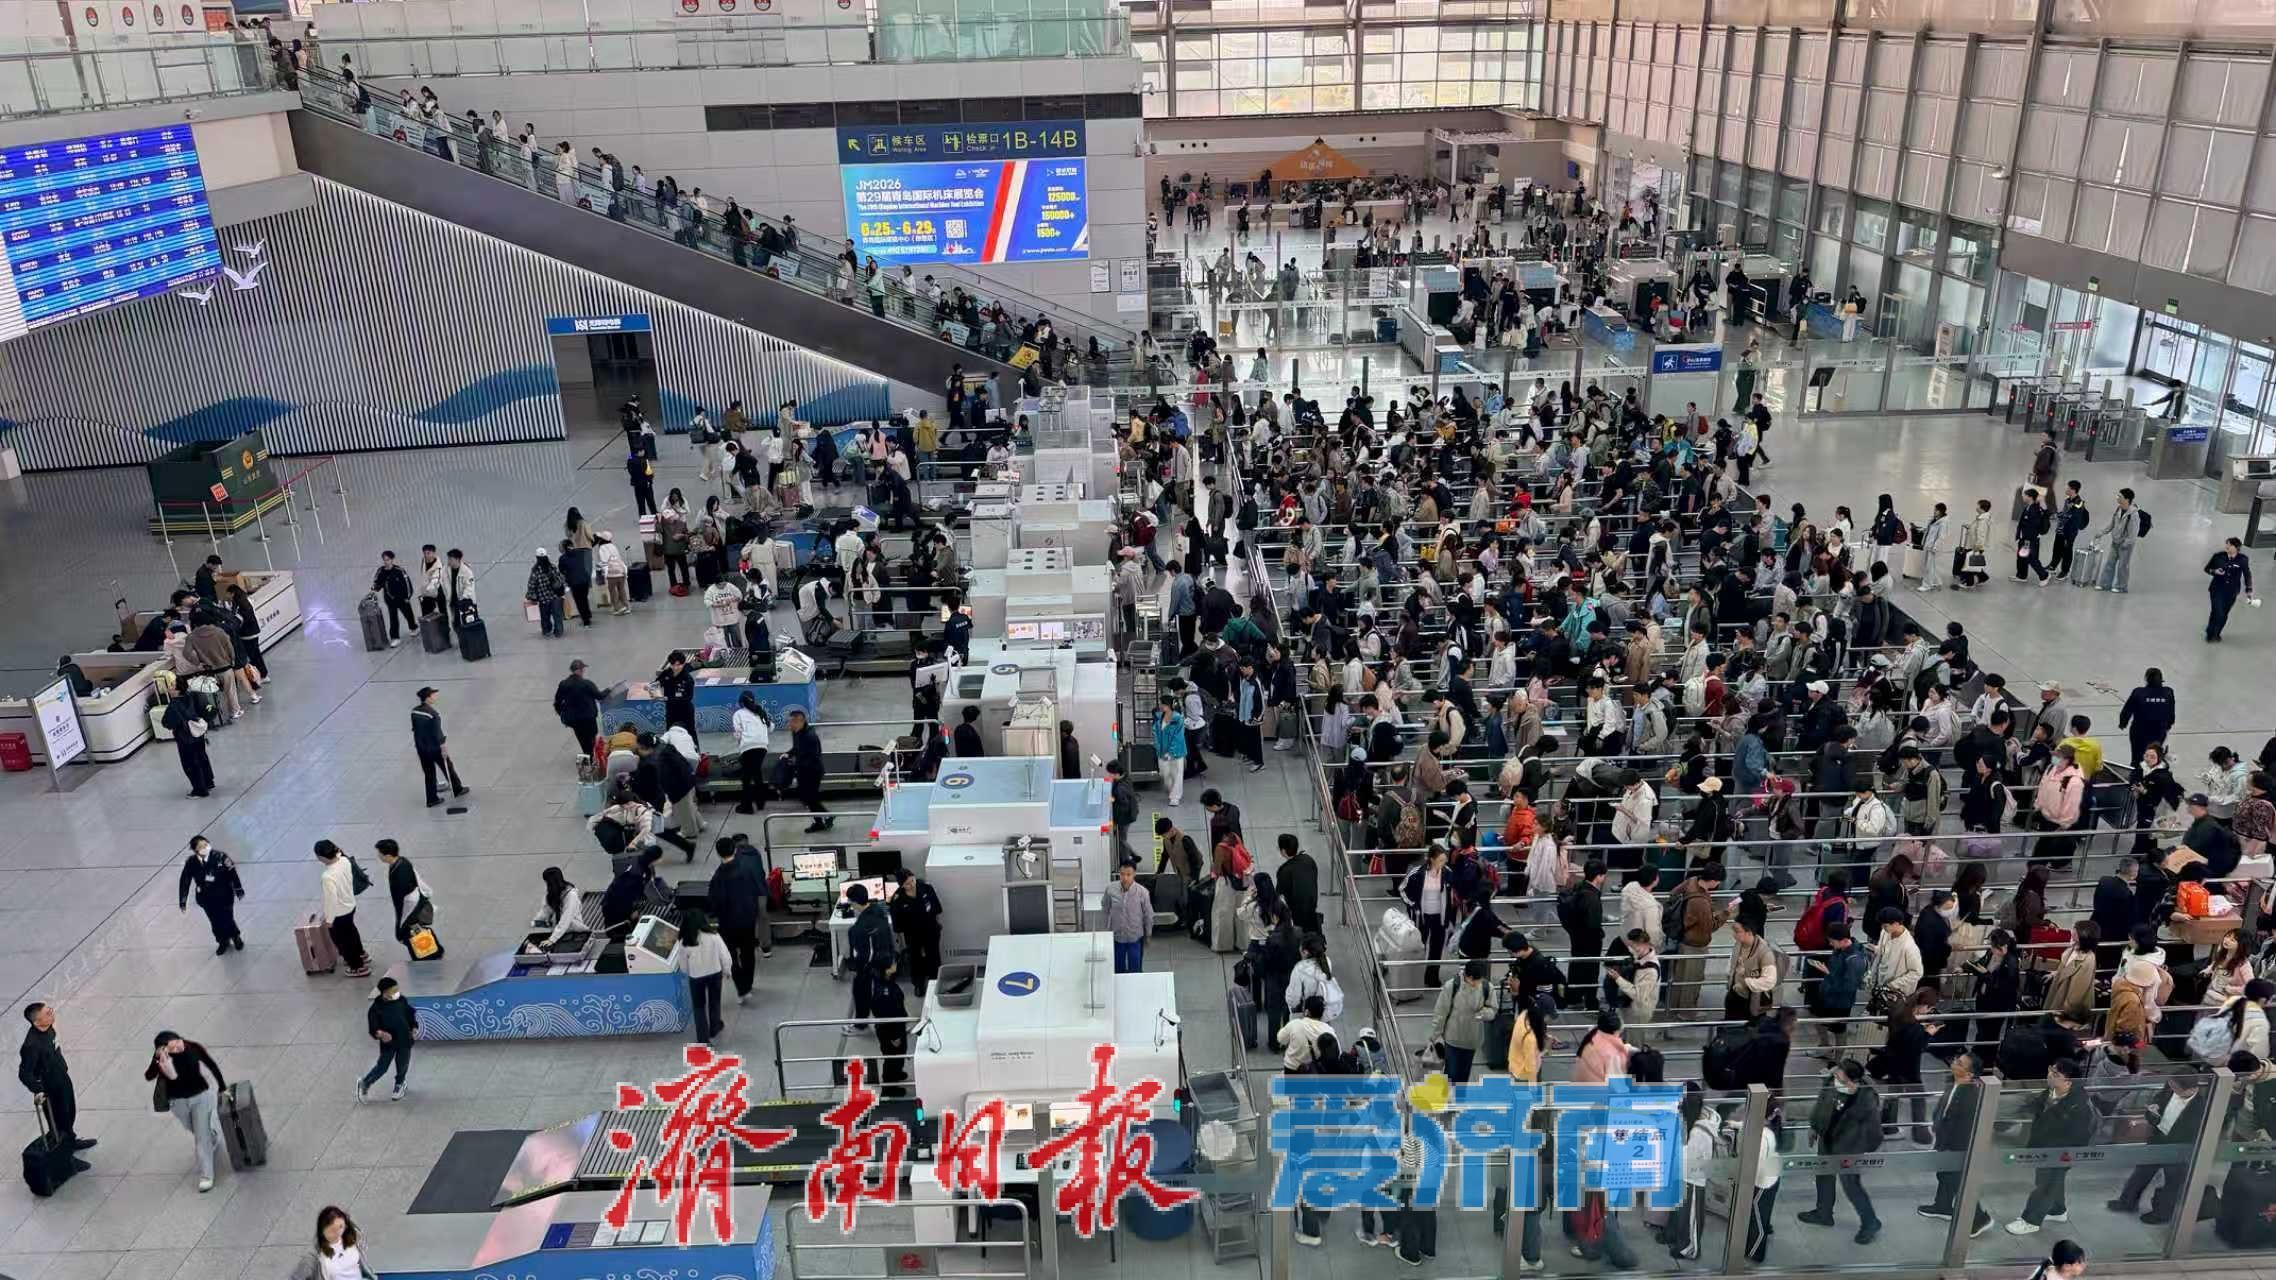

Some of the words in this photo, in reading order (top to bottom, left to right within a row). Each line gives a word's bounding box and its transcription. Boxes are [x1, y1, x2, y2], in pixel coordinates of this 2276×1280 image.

[891, 134, 926, 146] 候车区
[966, 132, 999, 144] 检票口
[1003, 129, 1078, 150] 1B-14B
[856, 178, 901, 190] JM2026
[1632, 1145, 1645, 1158] 2
